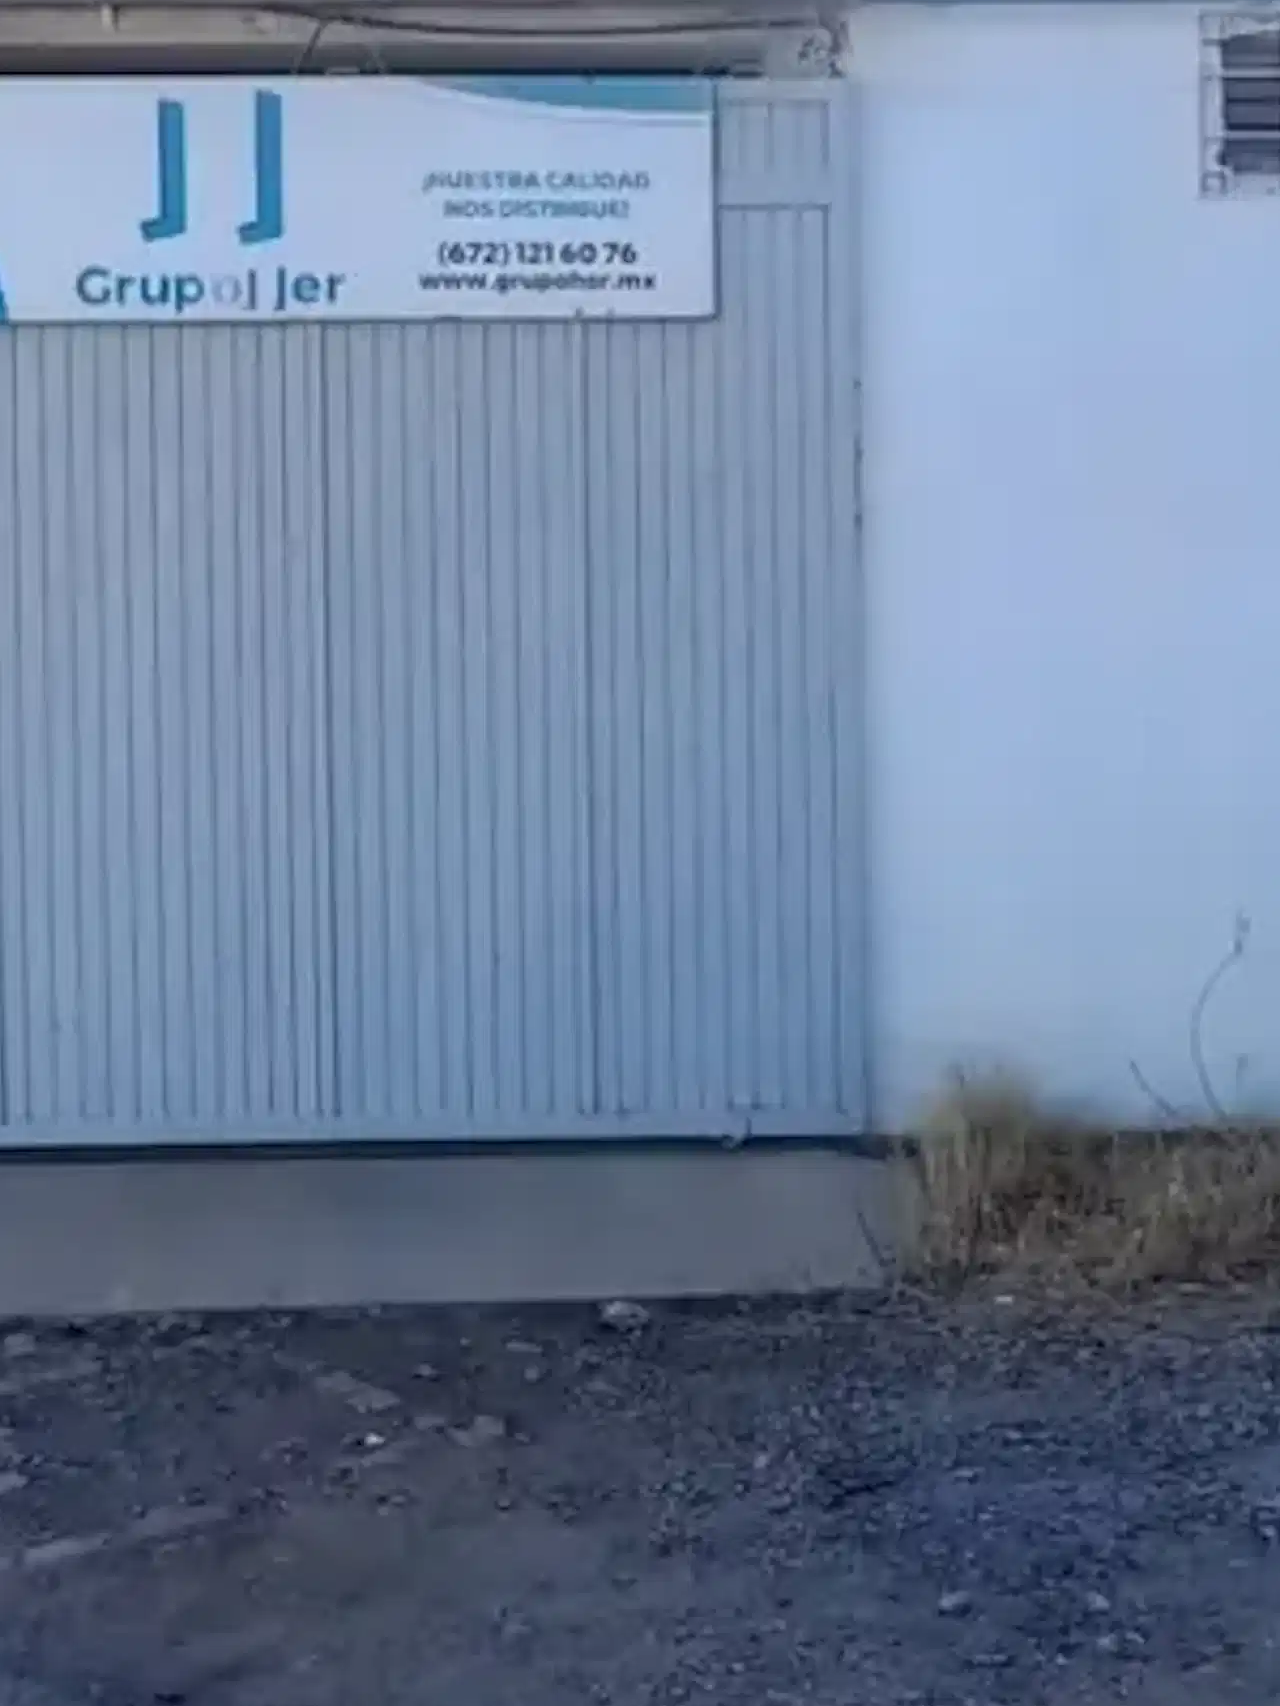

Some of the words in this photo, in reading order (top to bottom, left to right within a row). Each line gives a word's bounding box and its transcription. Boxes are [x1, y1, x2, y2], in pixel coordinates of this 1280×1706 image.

[545, 170, 651, 191] CALIDAD
[442, 199, 494, 219] NOS
[437, 241, 510, 266] (672)
[516, 242, 554, 265] 121
[559, 242, 598, 265] 60
[602, 242, 637, 265] 76
